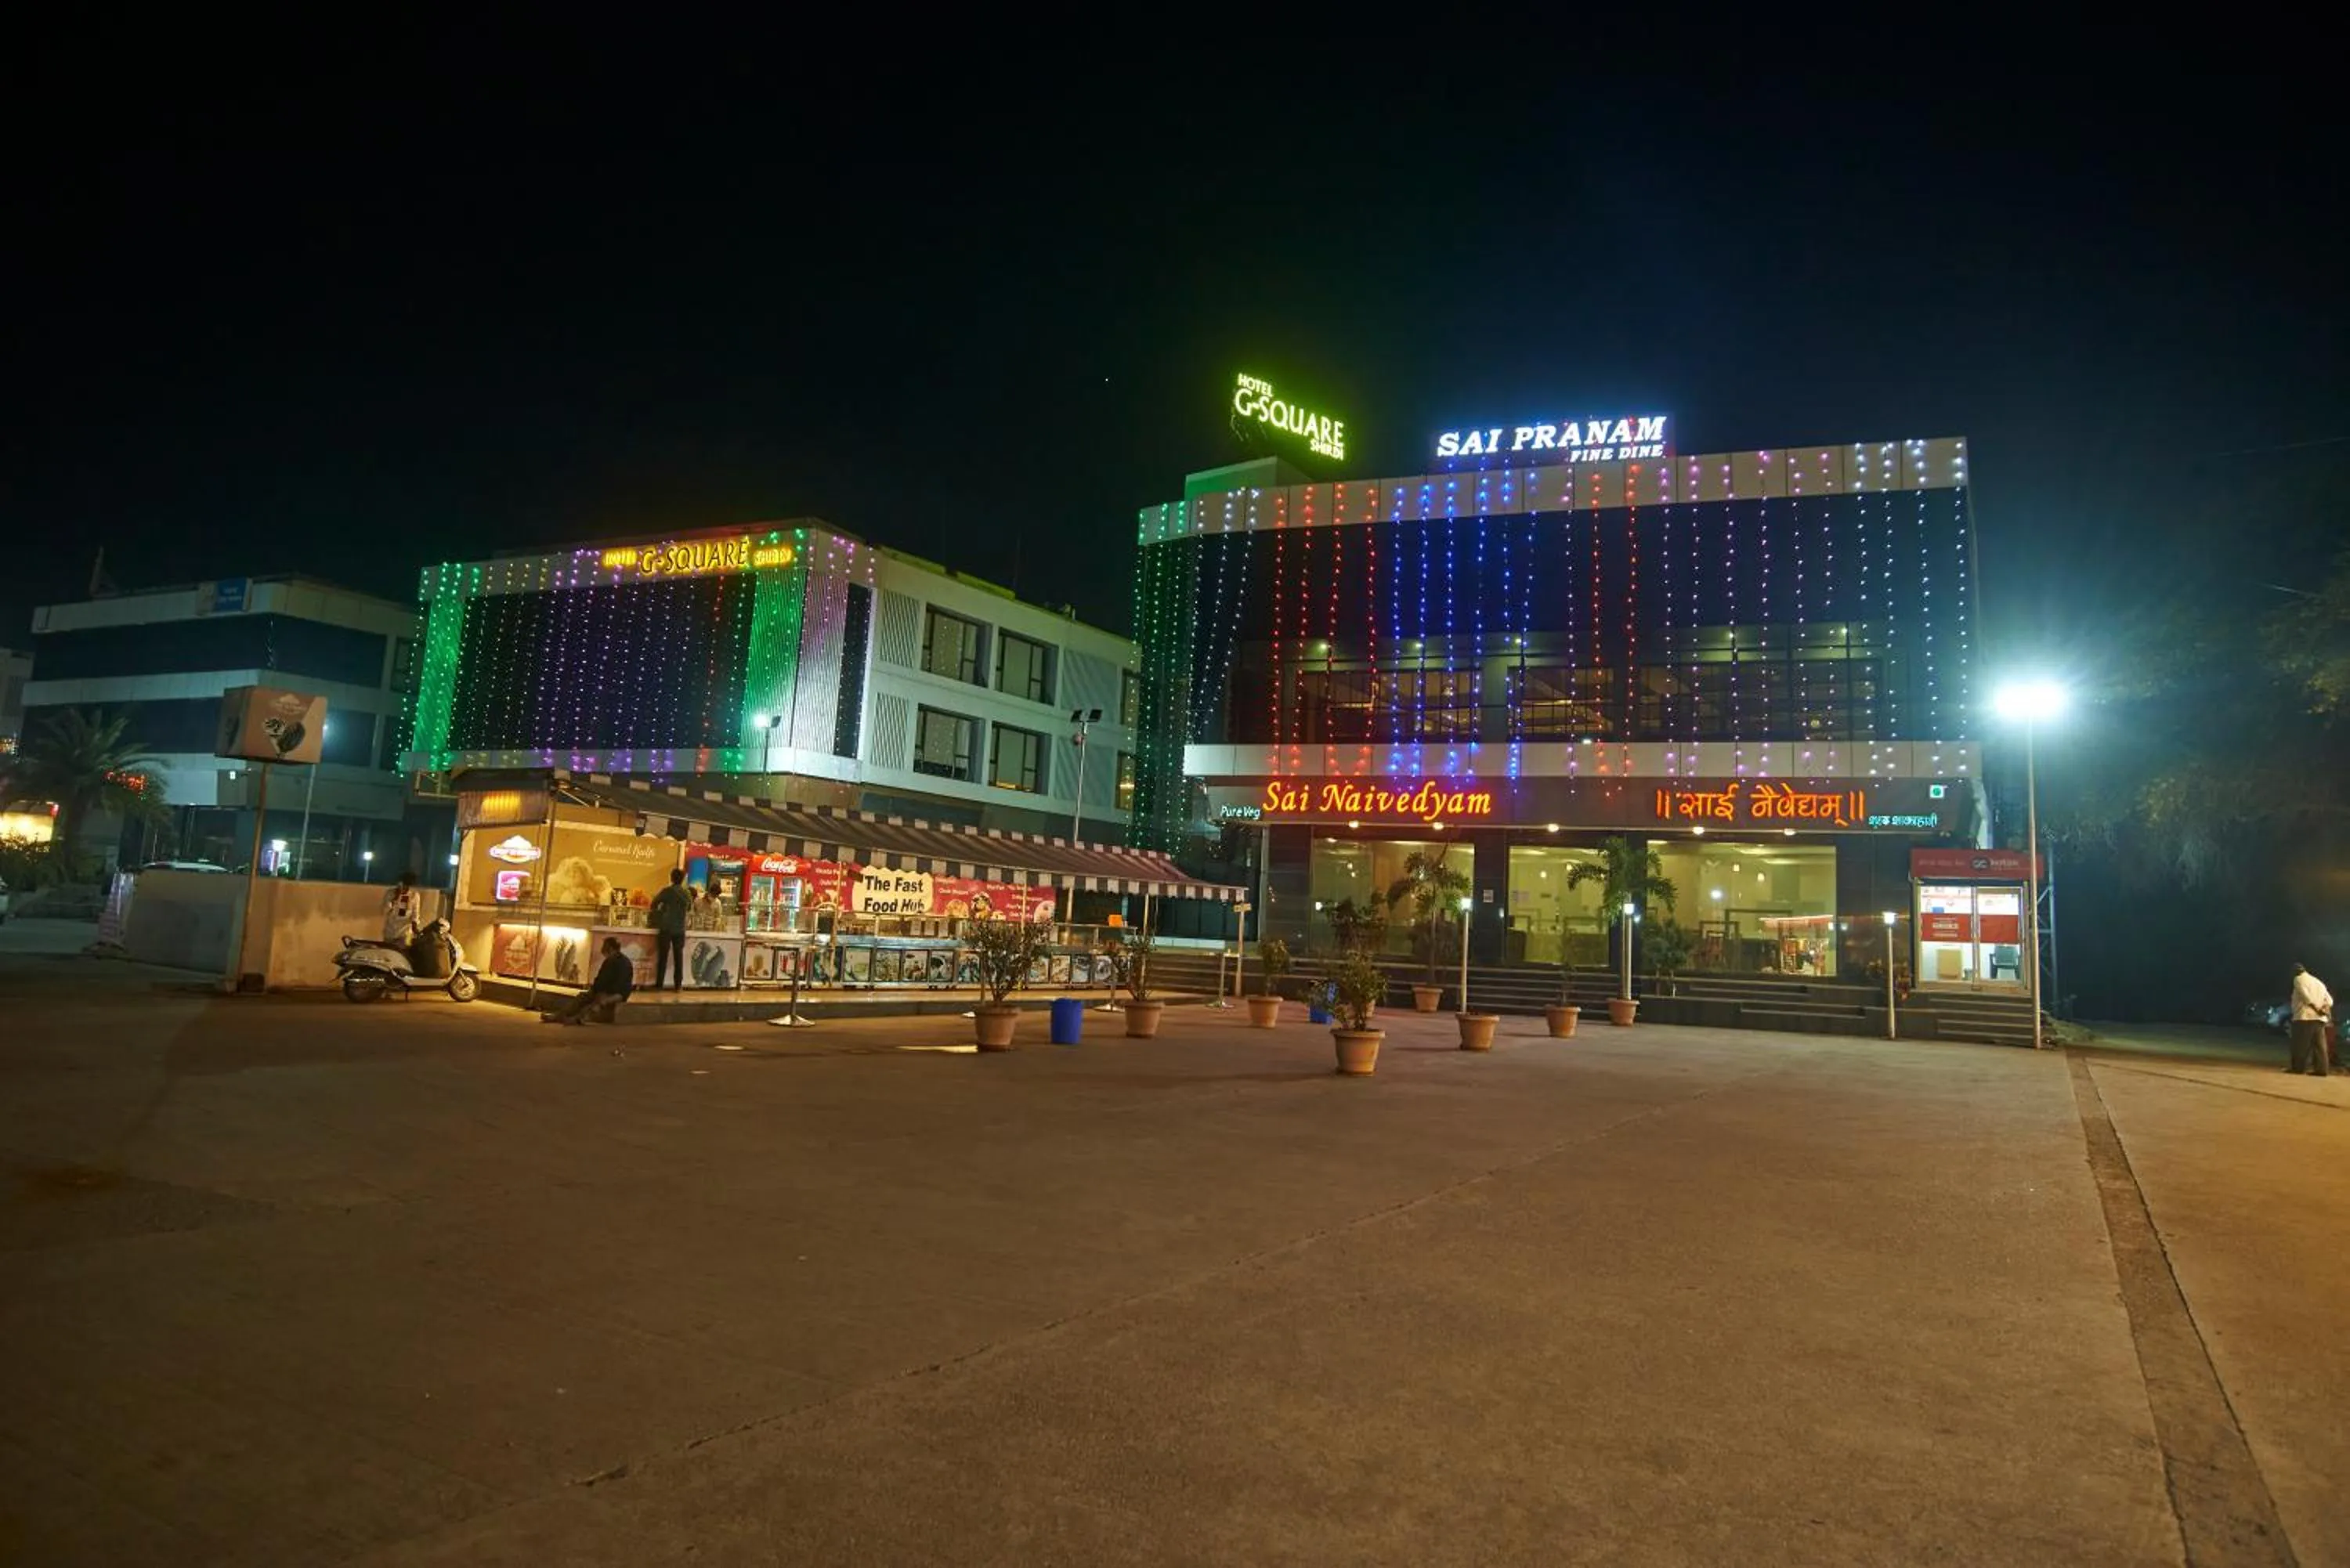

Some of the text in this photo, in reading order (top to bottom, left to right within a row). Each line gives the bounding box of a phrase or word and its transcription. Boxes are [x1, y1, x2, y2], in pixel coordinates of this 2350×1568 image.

[1238, 372, 1274, 397] HOTEL
[1235, 388, 1344, 446] G-SQUARE
[1437, 416, 1667, 456] SAI PRANAM
[1310, 439, 1344, 461] SHIRDI
[1570, 443, 1664, 463] FINE DINE
[641, 540, 747, 573] G-SQUARE
[1262, 780, 1492, 820] Sai Naivedyam
[865, 876, 891, 891] The
[894, 876, 924, 894] Fast
[864, 898, 897, 912] Food
